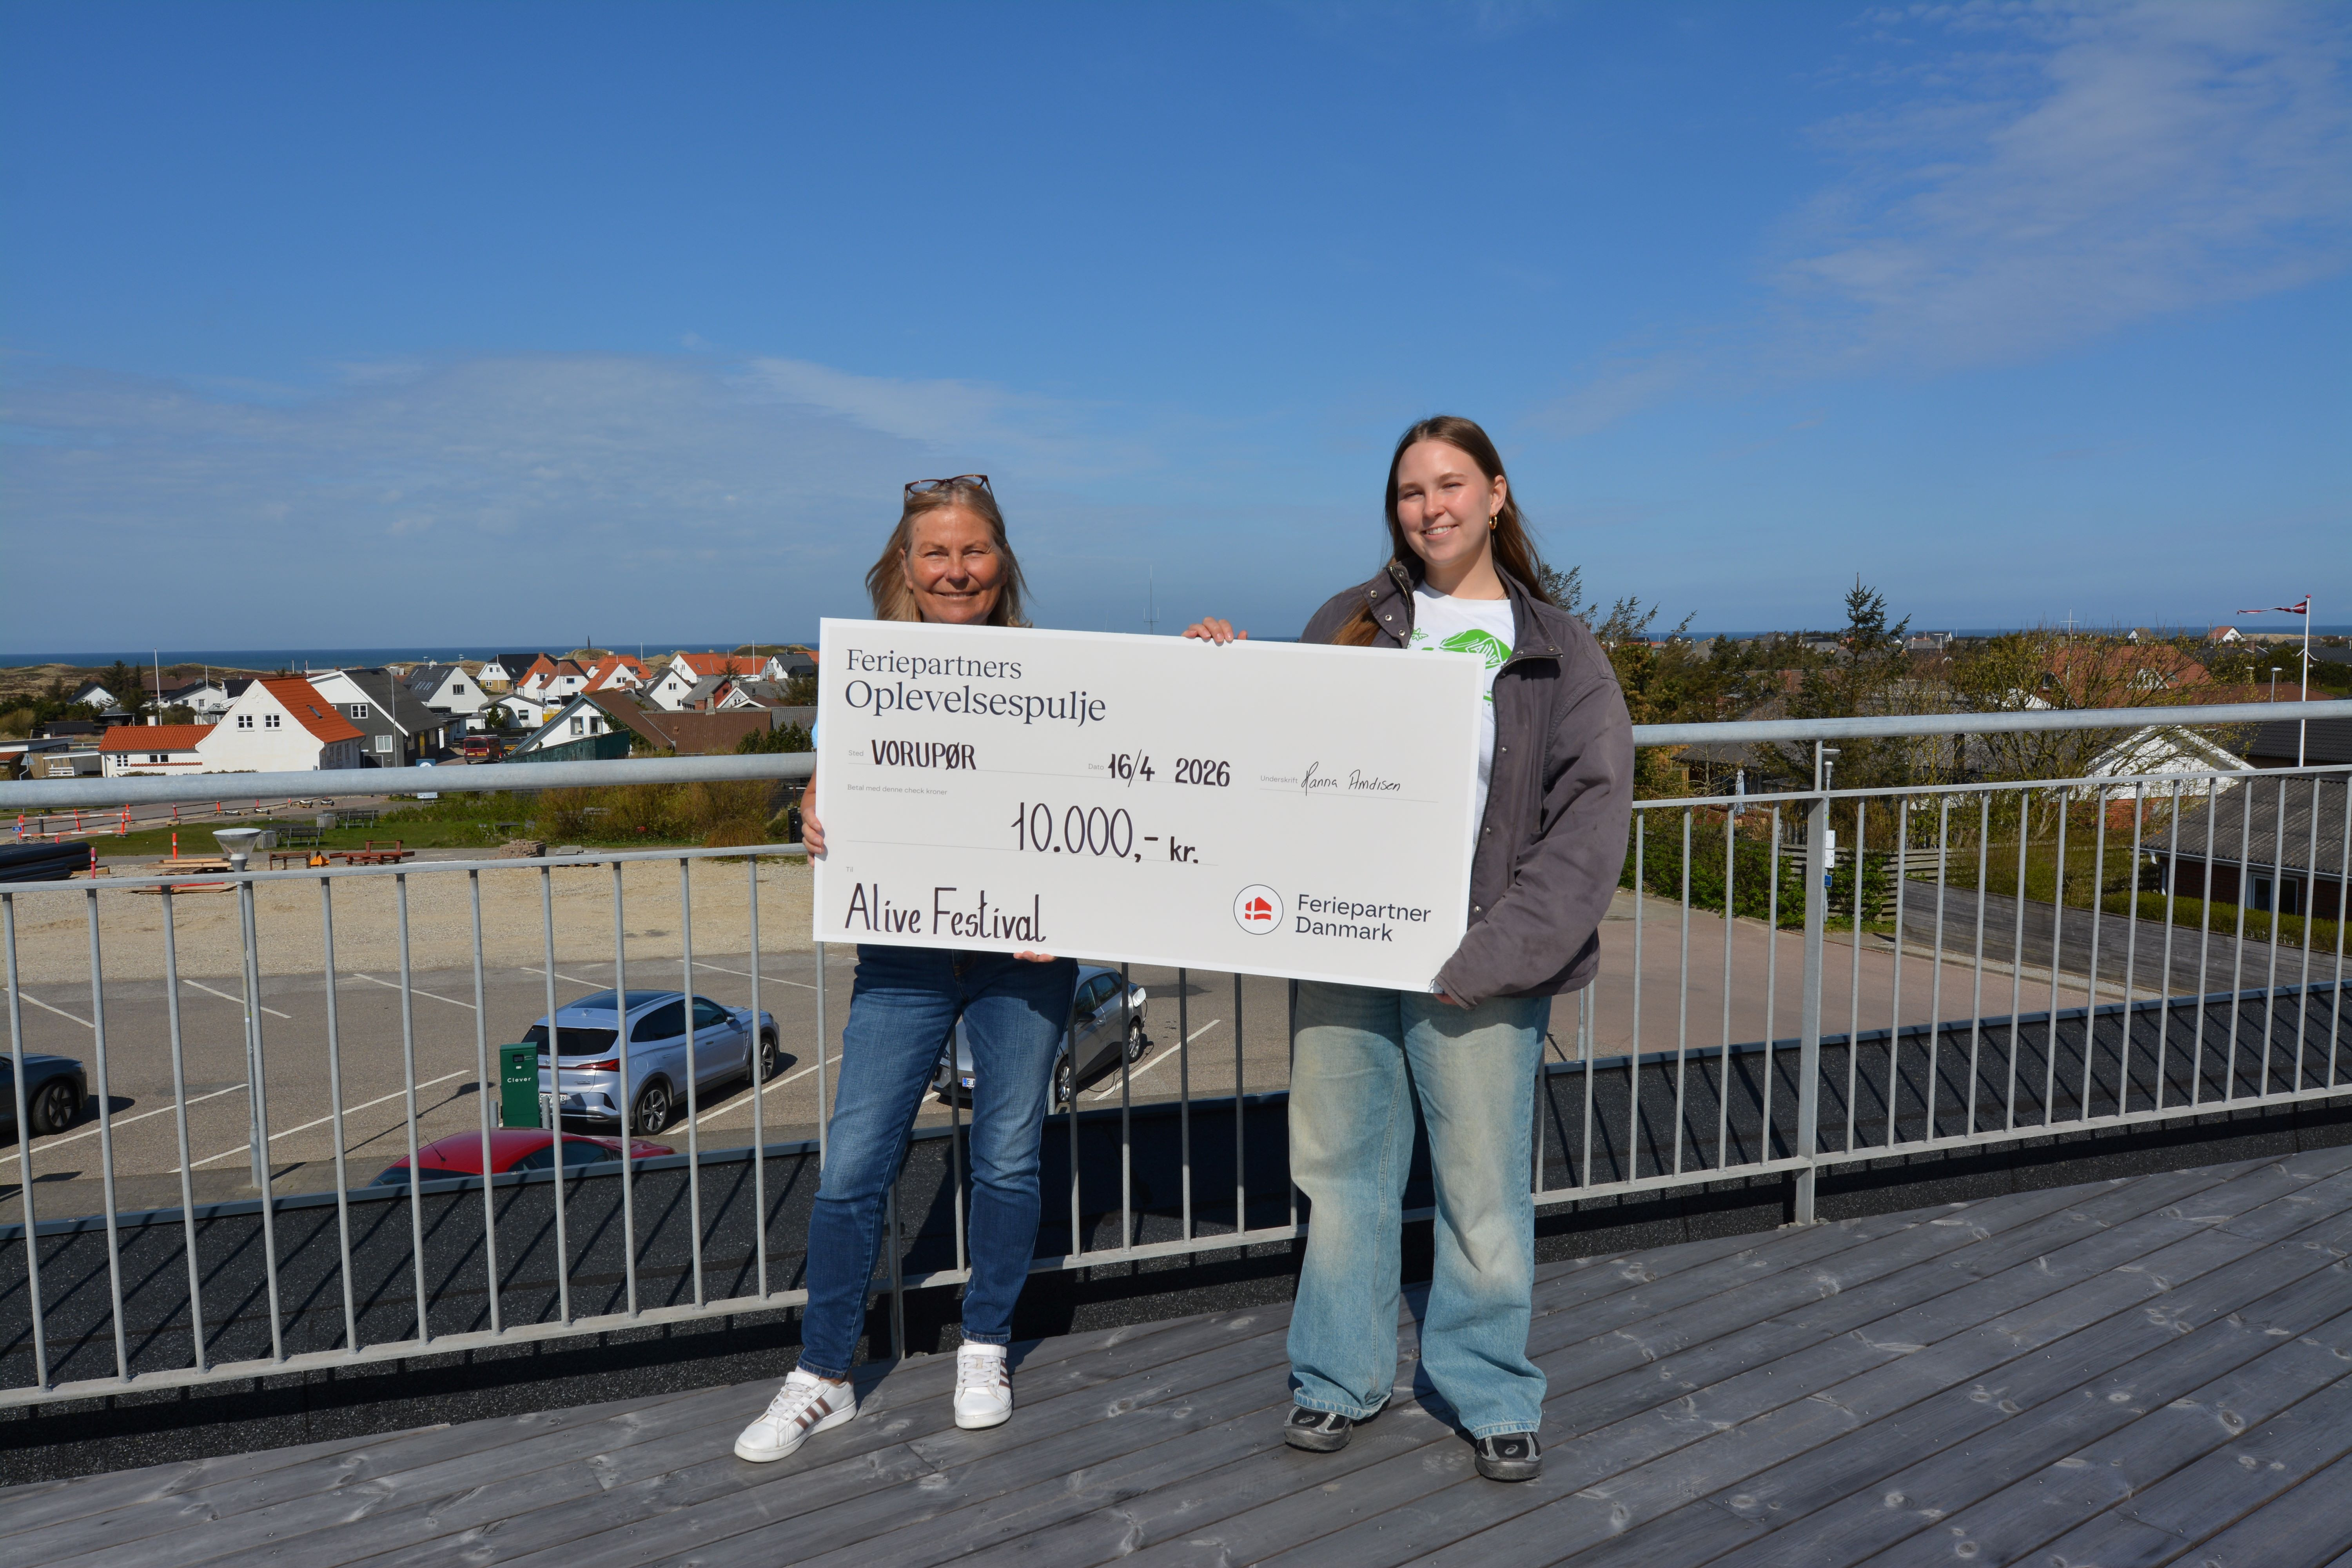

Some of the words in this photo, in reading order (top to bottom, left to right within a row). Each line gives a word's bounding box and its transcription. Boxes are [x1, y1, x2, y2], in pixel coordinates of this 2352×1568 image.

[846, 649, 1022, 679] Feriepartners
[845, 680, 1106, 727] Oplevelsespulje
[871, 739, 976, 770] VORUPØR
[1108, 749, 1155, 787] 16/4
[1175, 758, 1230, 787] 2026
[1260, 775, 1298, 784] Underskrift
[1170, 836, 1198, 864] kr.
[845, 883, 921, 933] Alive
[933, 887, 1047, 942] Festival
[1298, 894, 1432, 922] Feriepartner
[1295, 916, 1393, 942] Danmark
